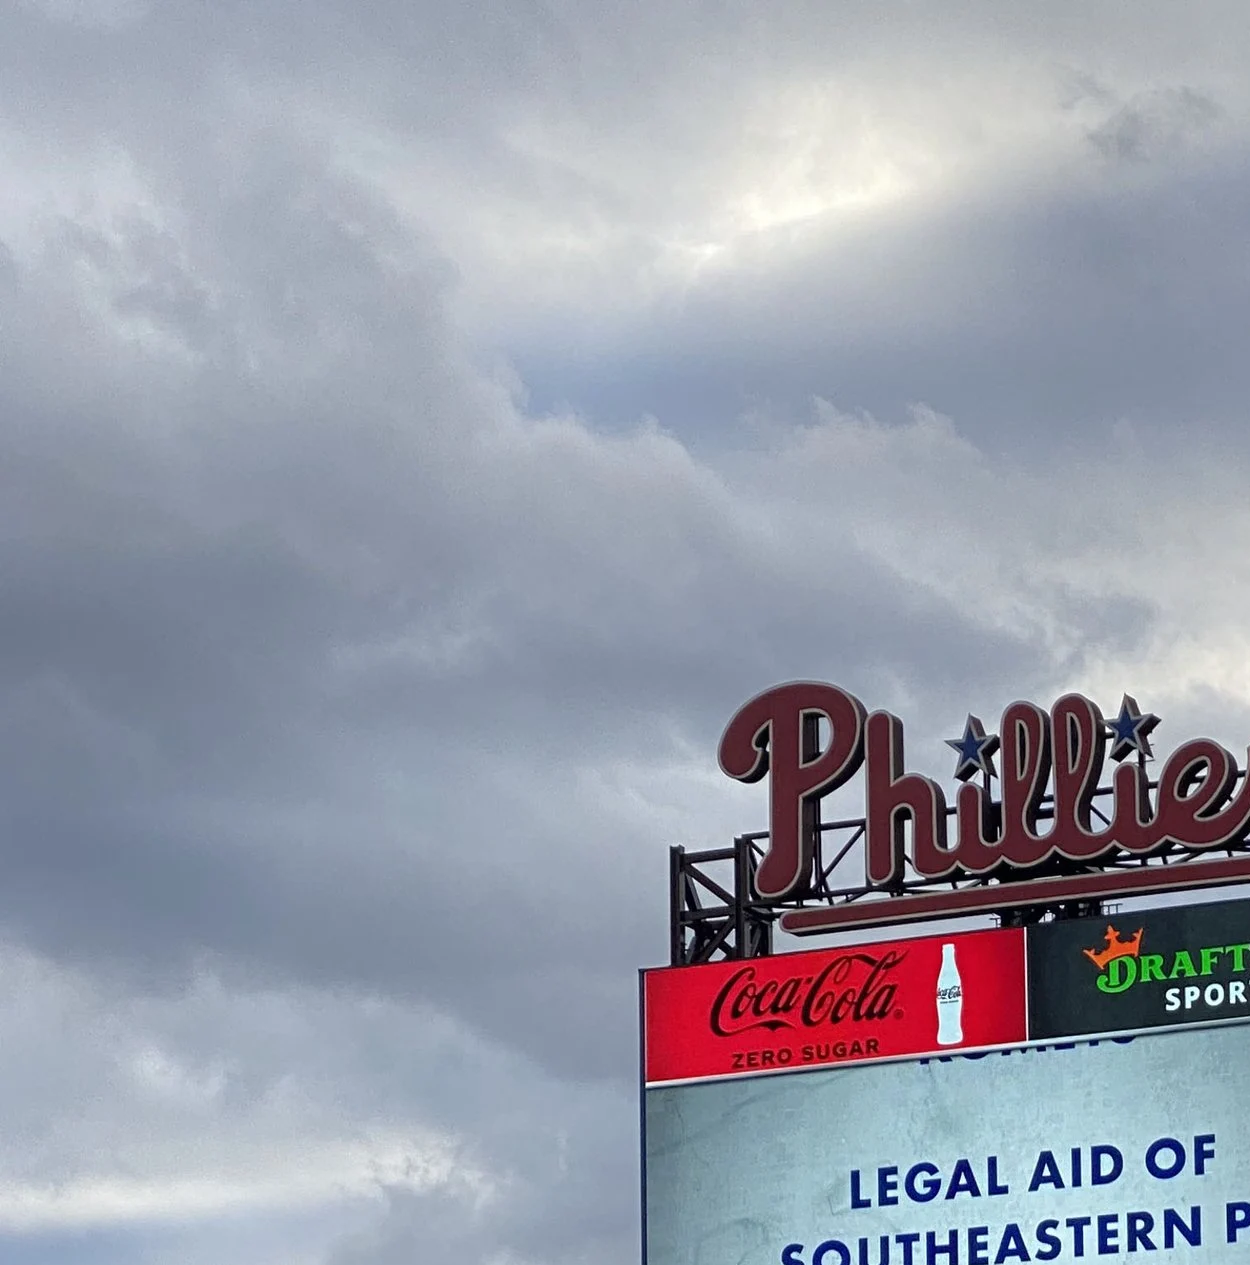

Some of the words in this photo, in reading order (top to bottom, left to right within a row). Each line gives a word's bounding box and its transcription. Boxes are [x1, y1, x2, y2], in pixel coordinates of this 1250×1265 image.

[710, 948, 909, 1037] Coca-Cola
[732, 1047, 792, 1069] ZERO
[803, 1038, 880, 1061] SUGAR
[850, 1156, 1009, 1210] LEGAL
[1028, 1144, 1124, 1192] AID
[1144, 1134, 1216, 1179] OF
